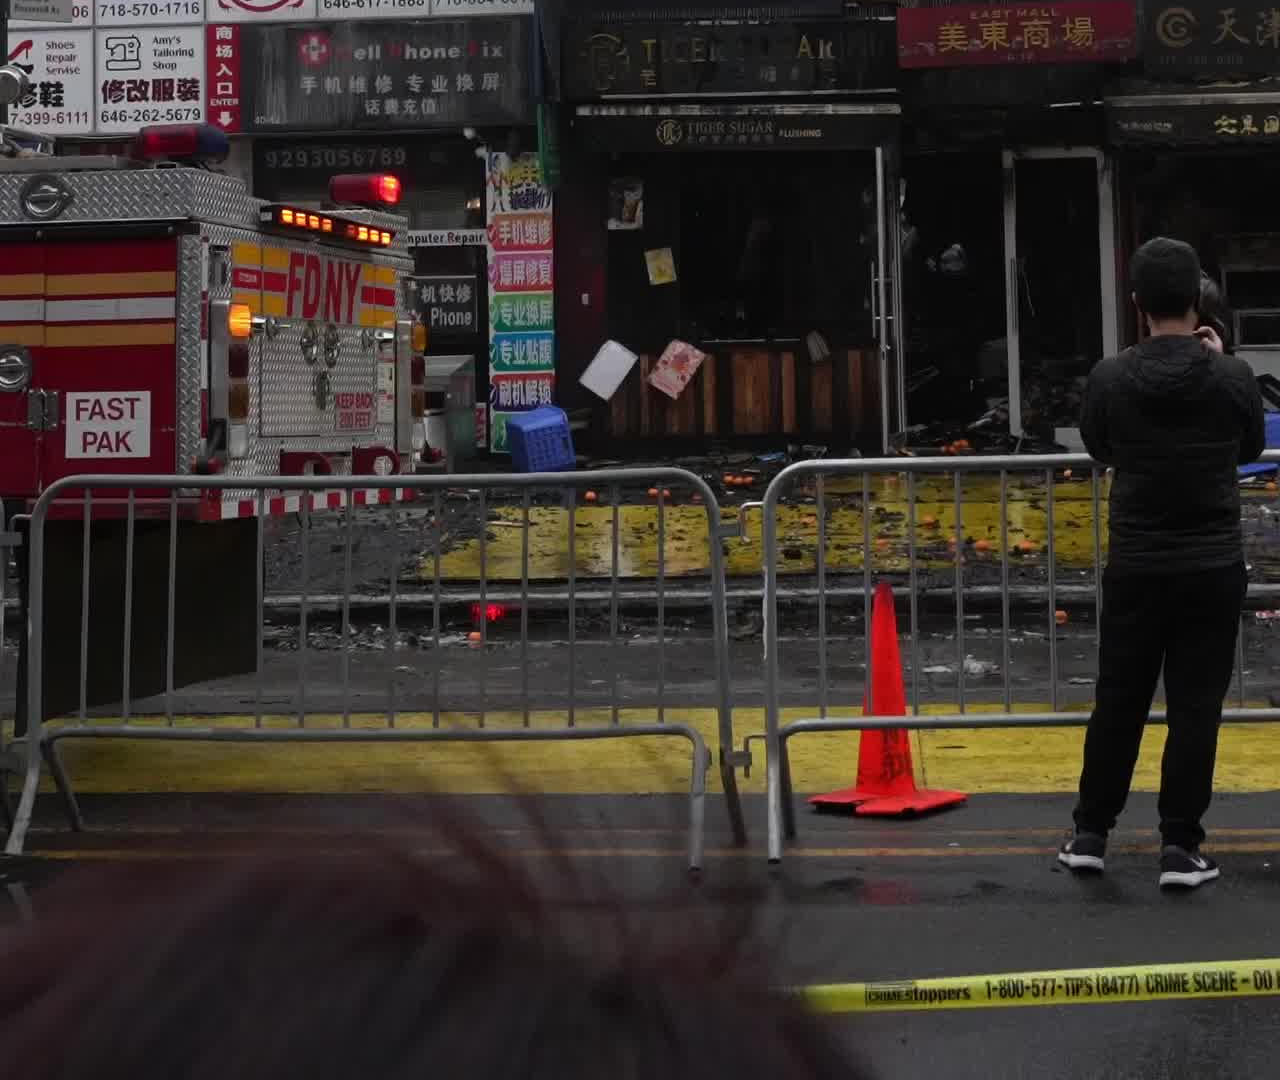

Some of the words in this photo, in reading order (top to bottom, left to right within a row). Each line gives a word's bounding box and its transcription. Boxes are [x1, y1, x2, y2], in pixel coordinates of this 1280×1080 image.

[99, 2, 200, 17] 718-570-1716
[152, 35, 182, 46] Amy's
[936, 16, 1095, 52] 美東商場
[46, 41, 75, 50] Shoes
[153, 48, 194, 58] Tailoring
[46, 53, 78, 64] Repair
[152, 61, 177, 71] Shop
[216, 26, 233, 95] 商场入口
[301, 75, 394, 94] 手机维修
[407, 73, 500, 92] 专业换屏
[210, 98, 239, 106] ENTER
[364, 99, 437, 115] 话费充值
[101, 108, 201, 123] 646-262-5679
[448, 232, 483, 245] Repair
[499, 223, 552, 246] 手机维修
[287, 251, 361, 324] FDNY
[431, 308, 472, 326] Phone
[336, 393, 355, 408] KEEP
[75, 398, 140, 421] FAST
[81, 431, 133, 454] PAK
[985, 975, 1093, 999] 1-800-577-TIPS
[1145, 972, 1189, 993] CRIME
[1193, 971, 1237, 992] SCENE
[1253, 970, 1272, 990] DO
